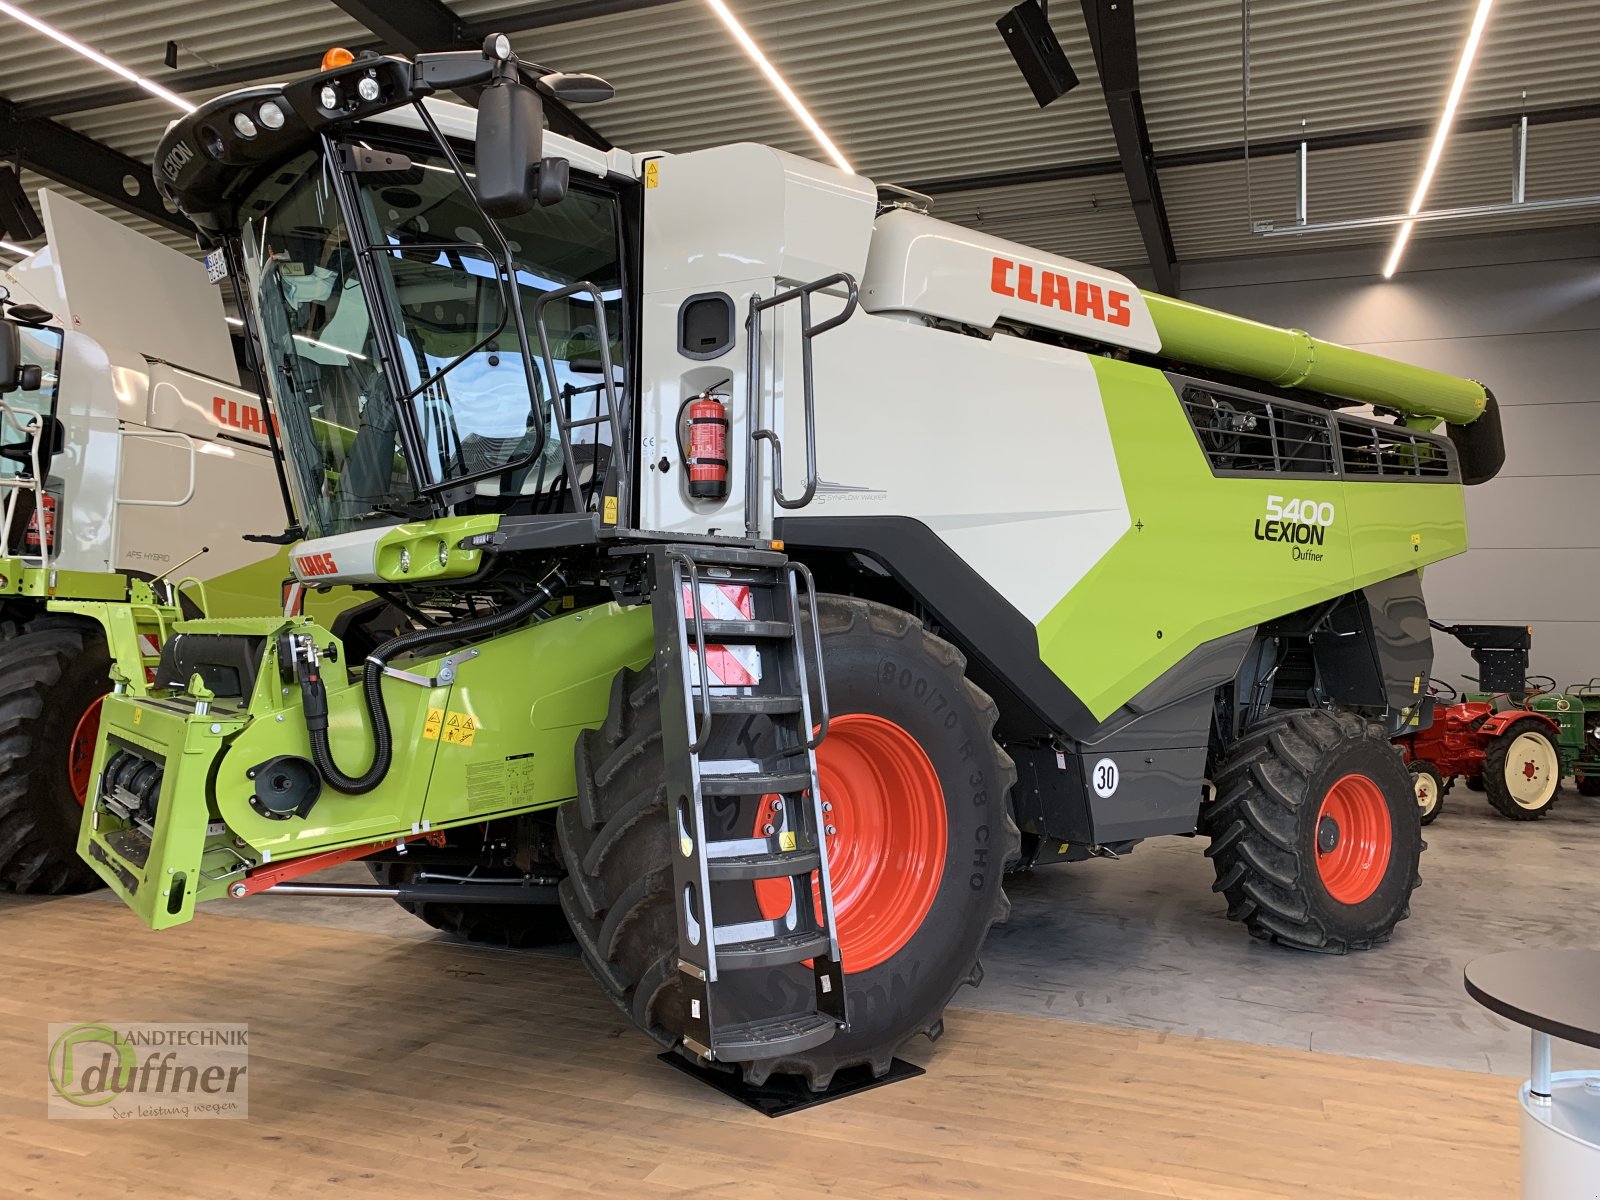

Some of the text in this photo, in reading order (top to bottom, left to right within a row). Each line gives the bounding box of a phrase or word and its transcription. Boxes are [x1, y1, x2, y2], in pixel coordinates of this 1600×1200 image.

[161, 140, 194, 181] LEXION
[991, 257, 1131, 327] CLAAS
[213, 397, 280, 438] CLA
[1265, 495, 1335, 527] 5400
[1254, 518, 1325, 546] LEXION
[126, 550, 170, 562] APS HYBRID
[296, 552, 338, 577] CLAAS
[1292, 545, 1324, 562] Duffner
[881, 661, 959, 730] 800/70
[968, 824, 990, 892] CHO
[1097, 766, 1115, 790] 30
